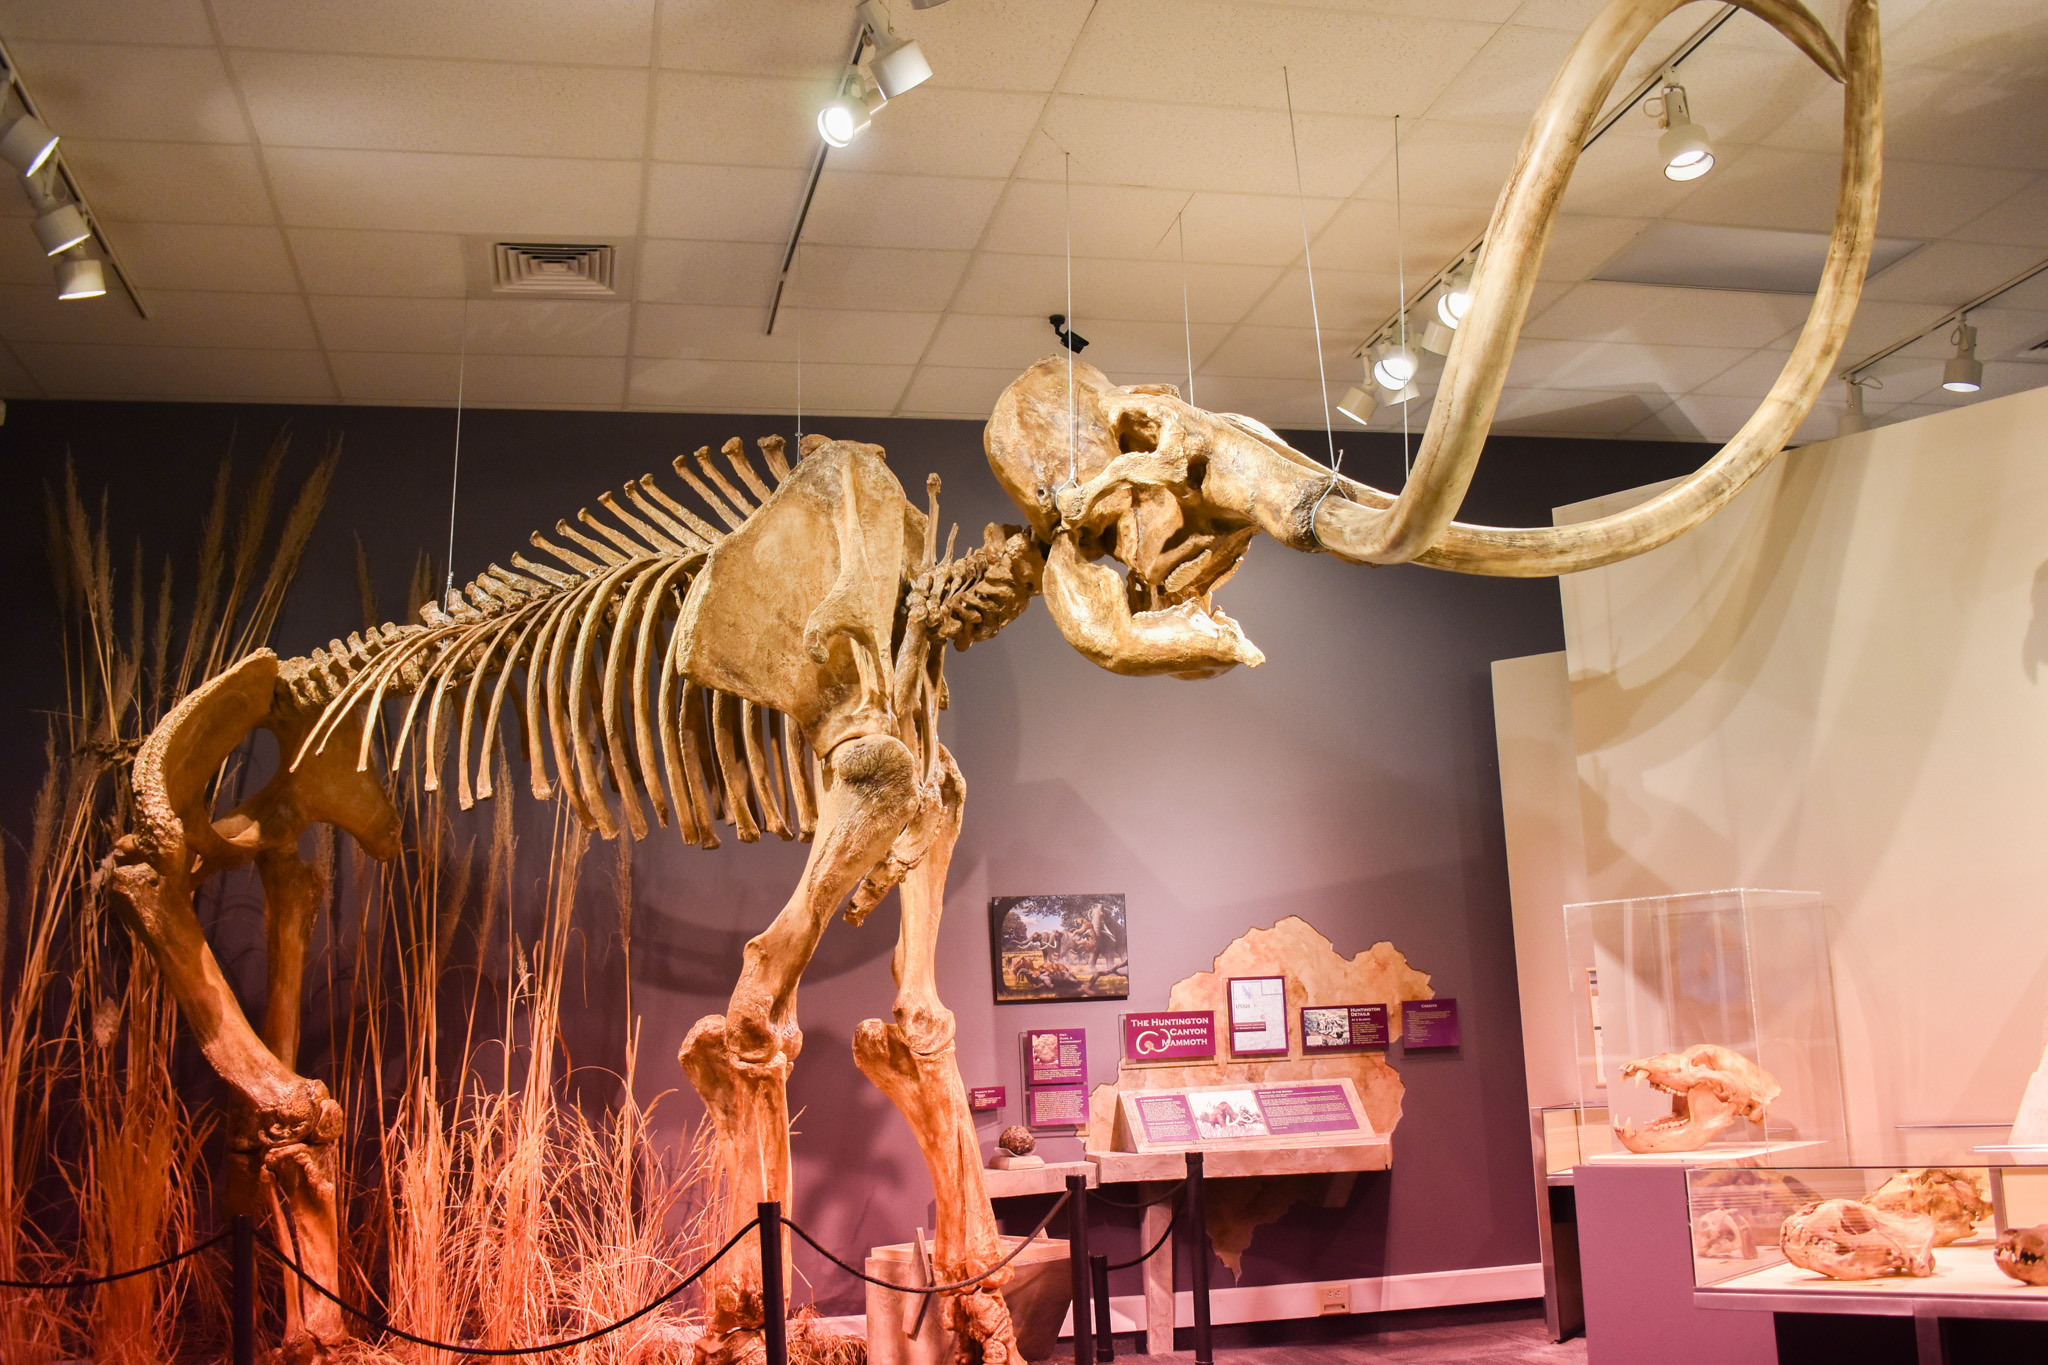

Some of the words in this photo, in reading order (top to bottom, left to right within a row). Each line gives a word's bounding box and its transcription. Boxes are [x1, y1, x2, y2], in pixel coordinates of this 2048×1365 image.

[1131, 1019, 1150, 1027] THE
[1151, 1017, 1209, 1026] HUNTINGTON
[1170, 1028, 1207, 1036] CANYON
[1162, 1038, 1208, 1046] MAMMOTH
